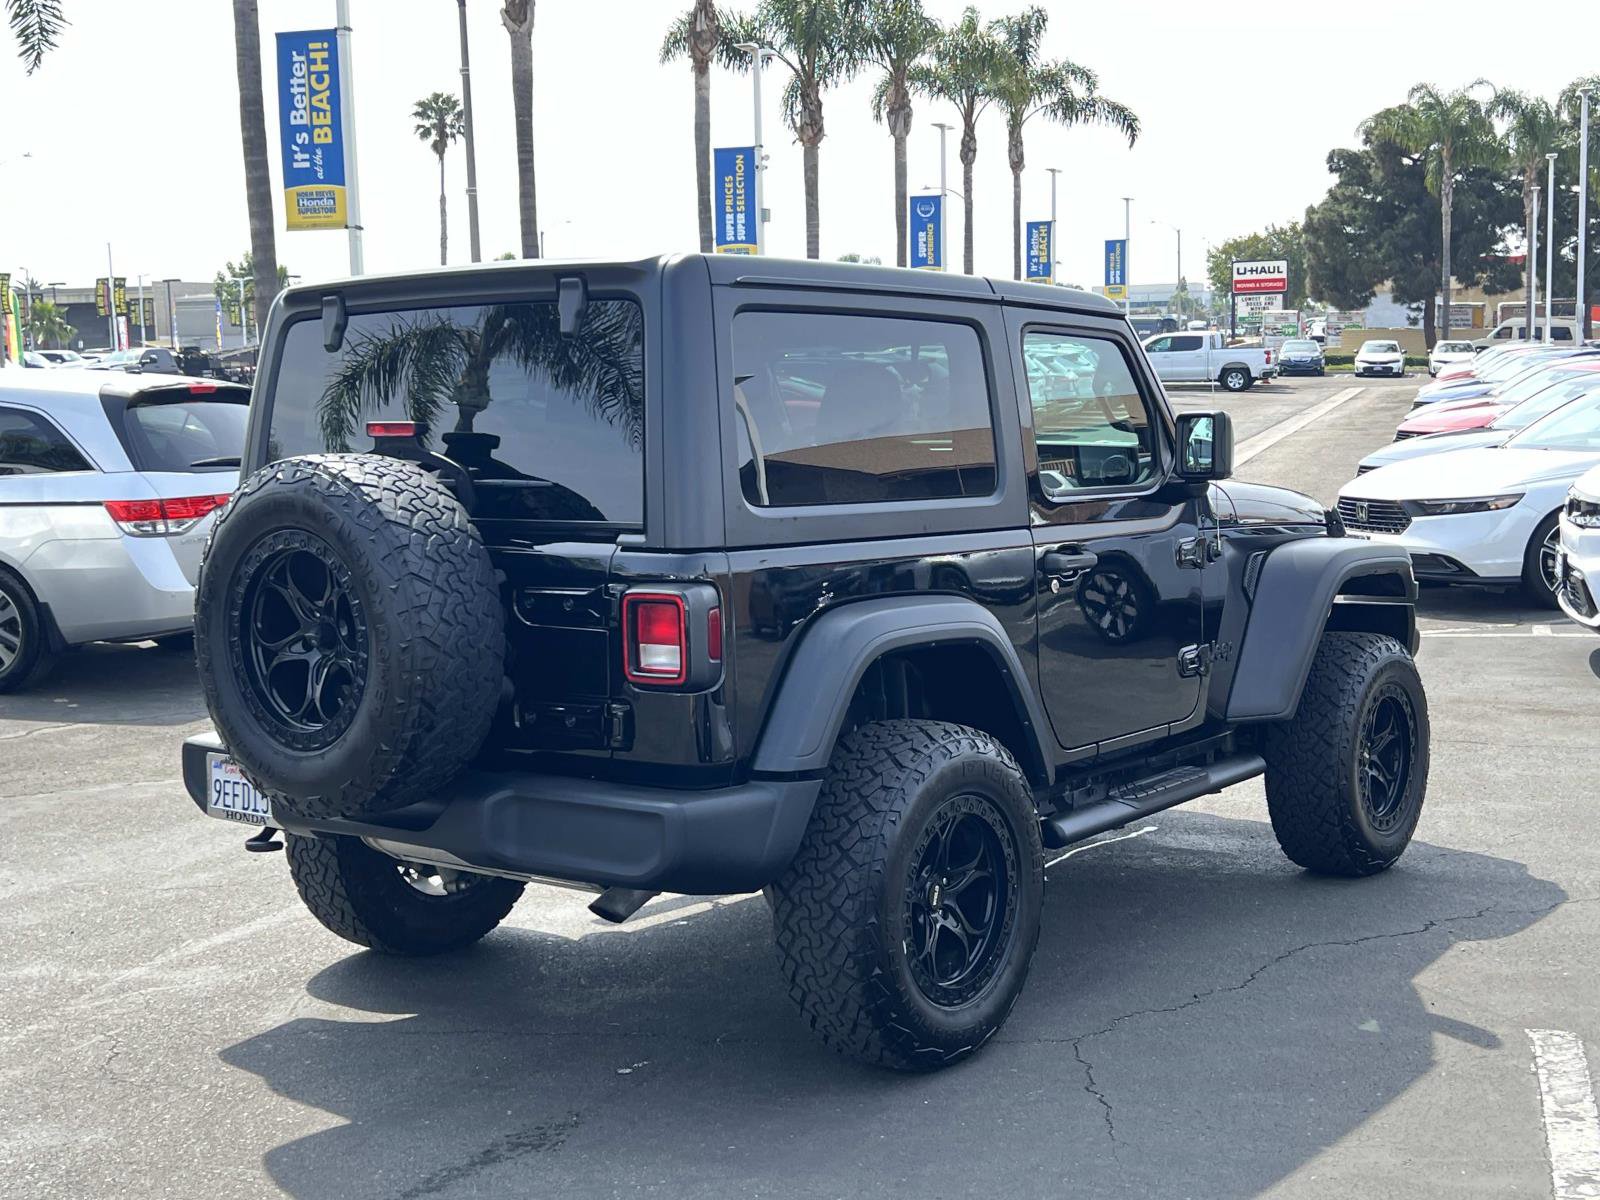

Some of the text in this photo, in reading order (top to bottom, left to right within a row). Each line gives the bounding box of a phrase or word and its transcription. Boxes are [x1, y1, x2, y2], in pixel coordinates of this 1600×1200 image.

[290, 50, 310, 169] It's Better
[308, 42, 333, 145] BEACH!
[298, 198, 334, 207] Honda
[724, 175, 735, 241] SUPER PRICES
[735, 154, 746, 241] SUPER SELECTION
[918, 231, 927, 258] SUPER
[1236, 265, 1283, 275] U-HAUL
[225, 810, 267, 825] HONDA
